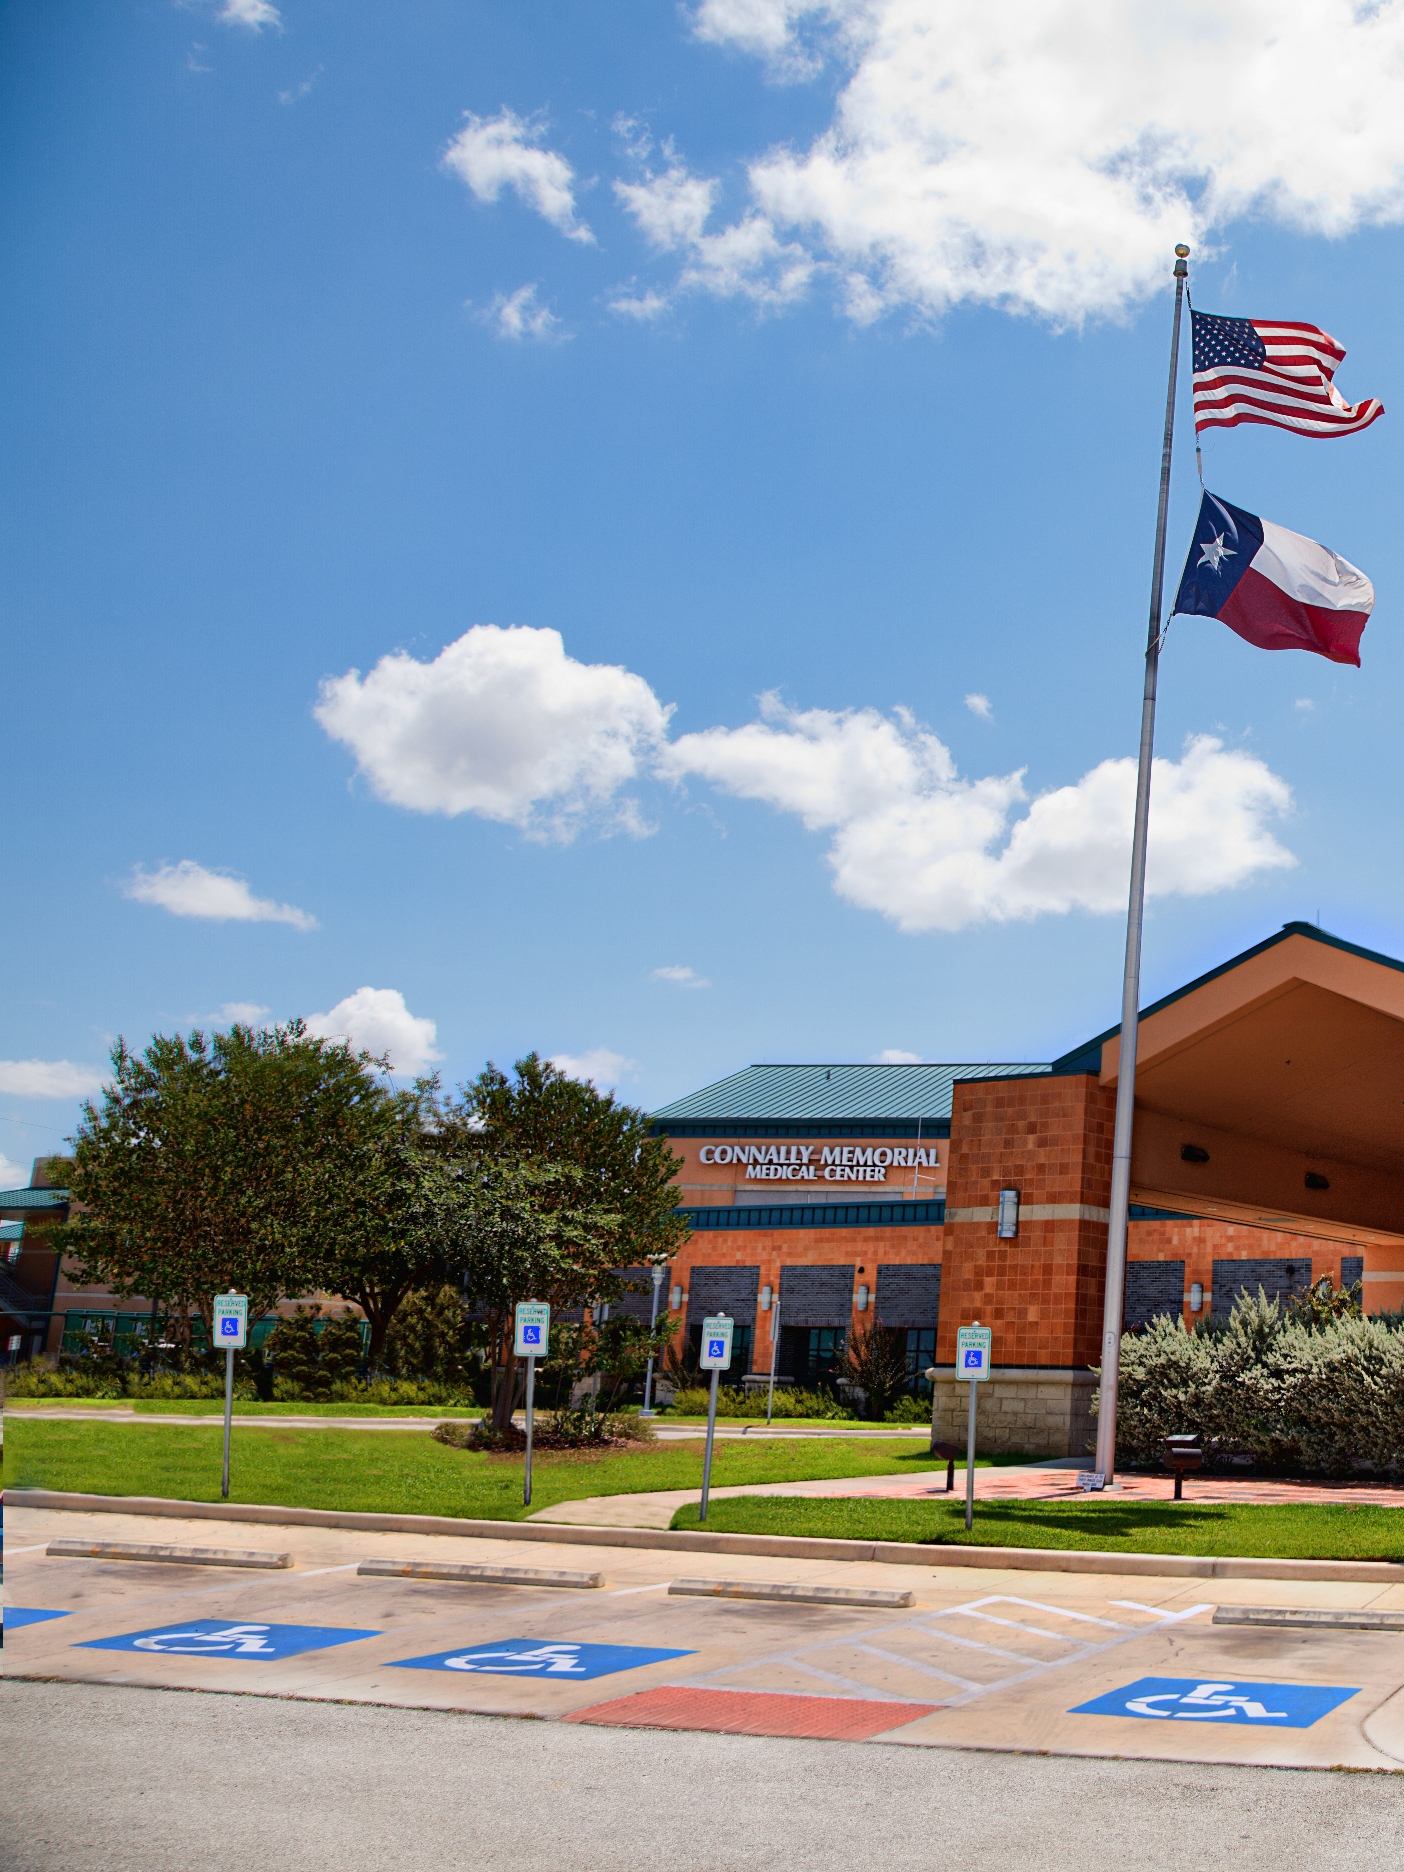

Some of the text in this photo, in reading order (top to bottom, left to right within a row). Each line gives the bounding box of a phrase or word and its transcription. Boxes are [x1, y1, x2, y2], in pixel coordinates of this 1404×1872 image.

[699, 1145, 941, 1167] CONNALLY MEMORIAL
[745, 1164, 886, 1181] MEDICAL CENTER
[706, 1322, 732, 1330] RESERVED
[706, 1331, 729, 1339] PARKING
